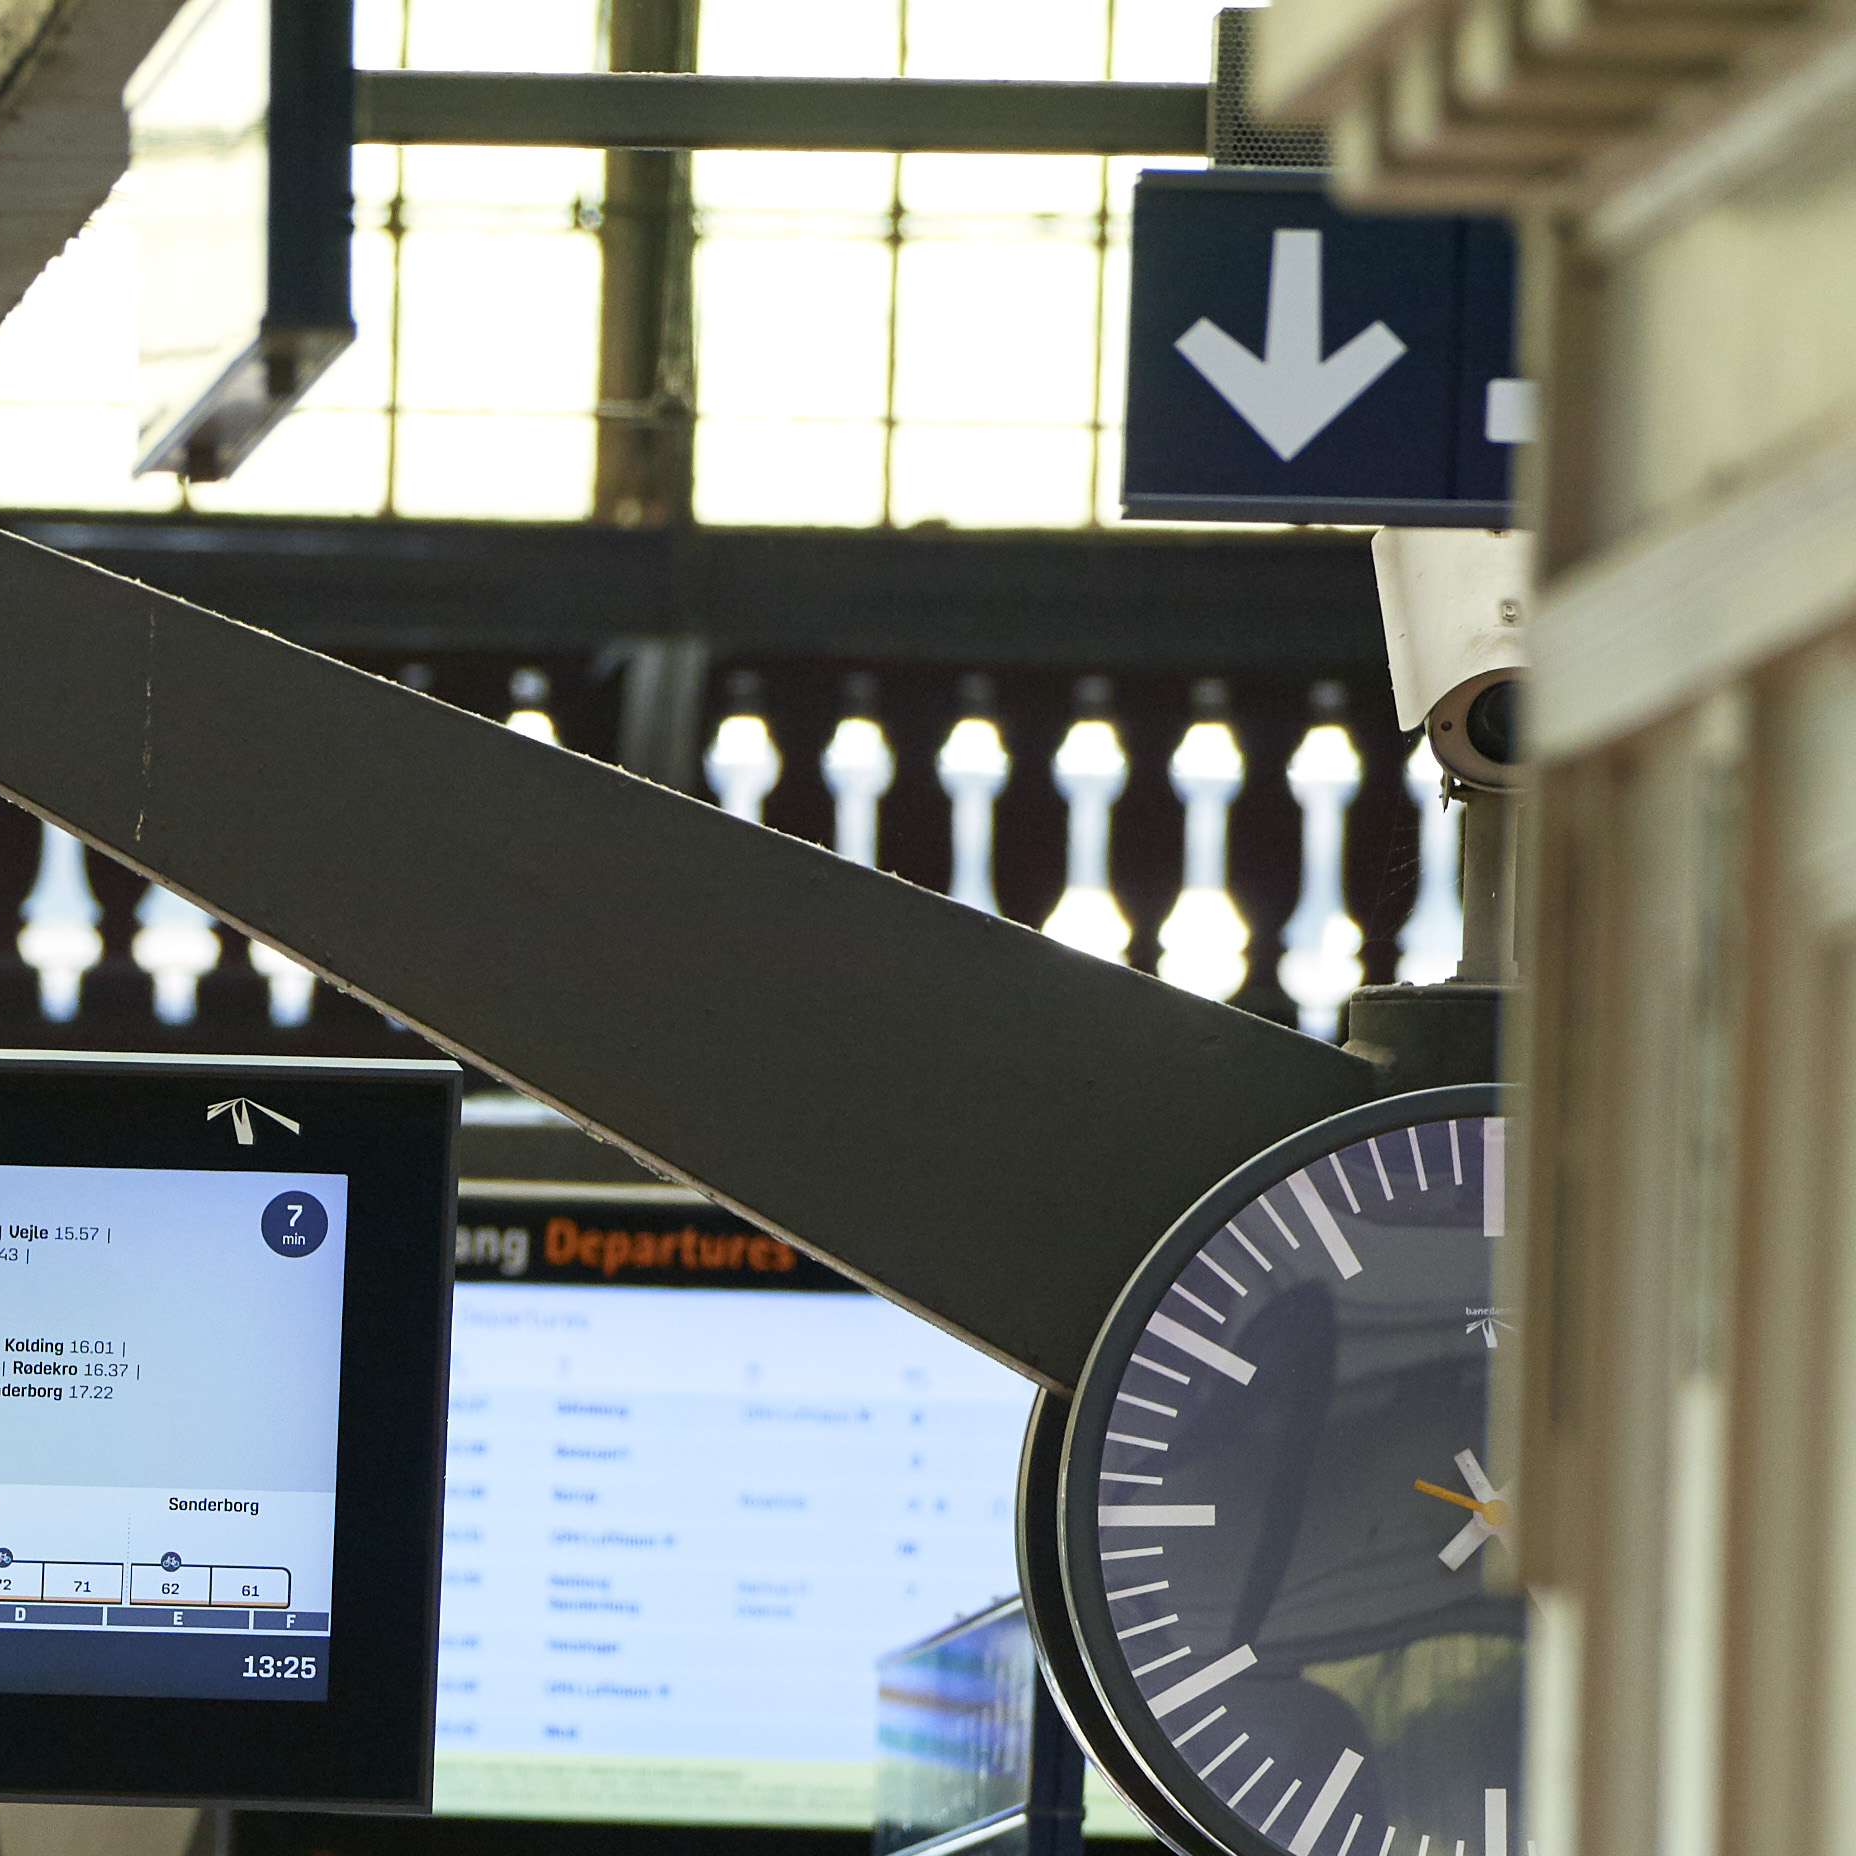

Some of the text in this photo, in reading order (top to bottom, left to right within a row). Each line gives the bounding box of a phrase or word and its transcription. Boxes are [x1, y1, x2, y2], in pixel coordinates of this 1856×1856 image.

[287, 1204, 303, 1227] 7
[9, 1224, 49, 1243] Vejle
[54, 1226, 99, 1241] 15.57
[282, 1232, 306, 1246] min
[545, 1216, 797, 1277] Departures
[5, 1337, 64, 1356] Kolding
[70, 1340, 114, 1355] 16.01
[13, 1360, 78, 1376] Rødekro
[84, 1363, 129, 1377] 16.37
[69, 1385, 113, 1400] 17.22
[168, 1497, 259, 1516] Sønderborg
[73, 1580, 92, 1593] 71
[161, 1582, 180, 1595] 62
[241, 1585, 260, 1597] 61
[14, 1606, 27, 1622] D
[173, 1611, 184, 1626] E
[286, 1614, 297, 1629] F
[242, 1655, 317, 1679] 13:25
